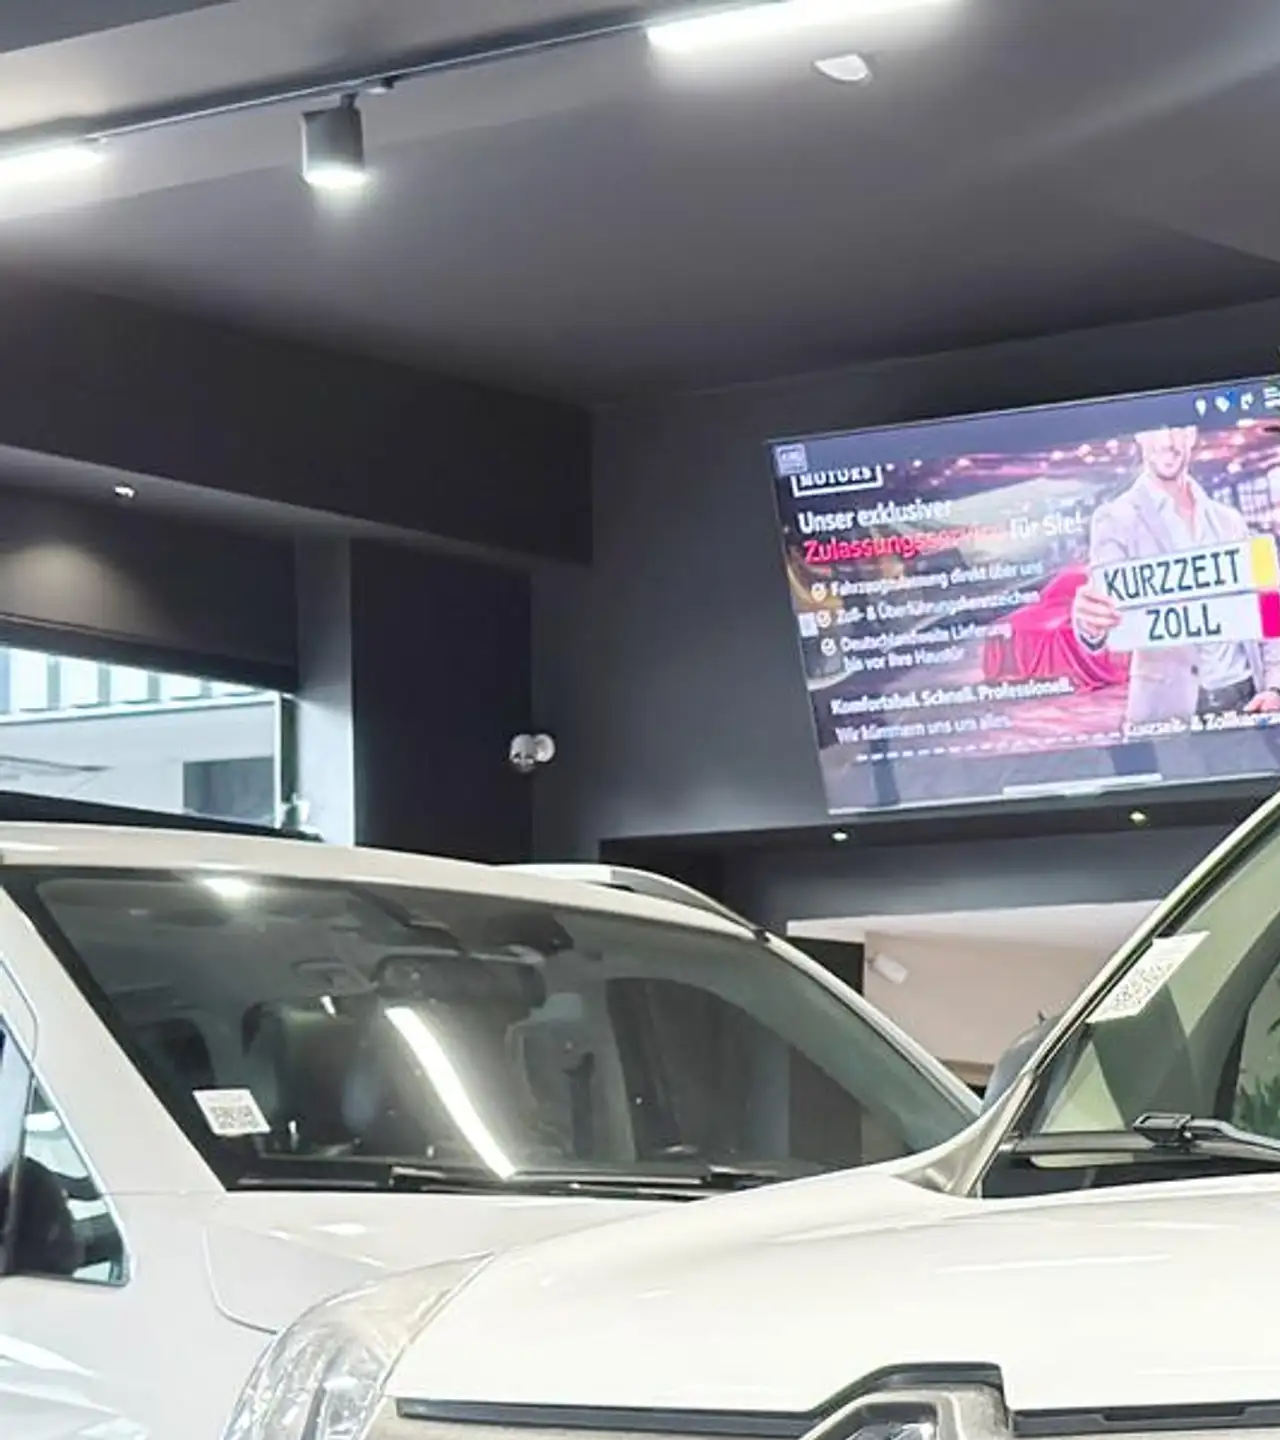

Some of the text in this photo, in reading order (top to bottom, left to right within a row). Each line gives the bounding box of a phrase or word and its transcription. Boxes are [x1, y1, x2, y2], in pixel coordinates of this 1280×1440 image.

[798, 498, 950, 534] Unser exklusiver
[1104, 548, 1240, 601] KURZZEIT
[1146, 603, 1222, 641] ZOLL
